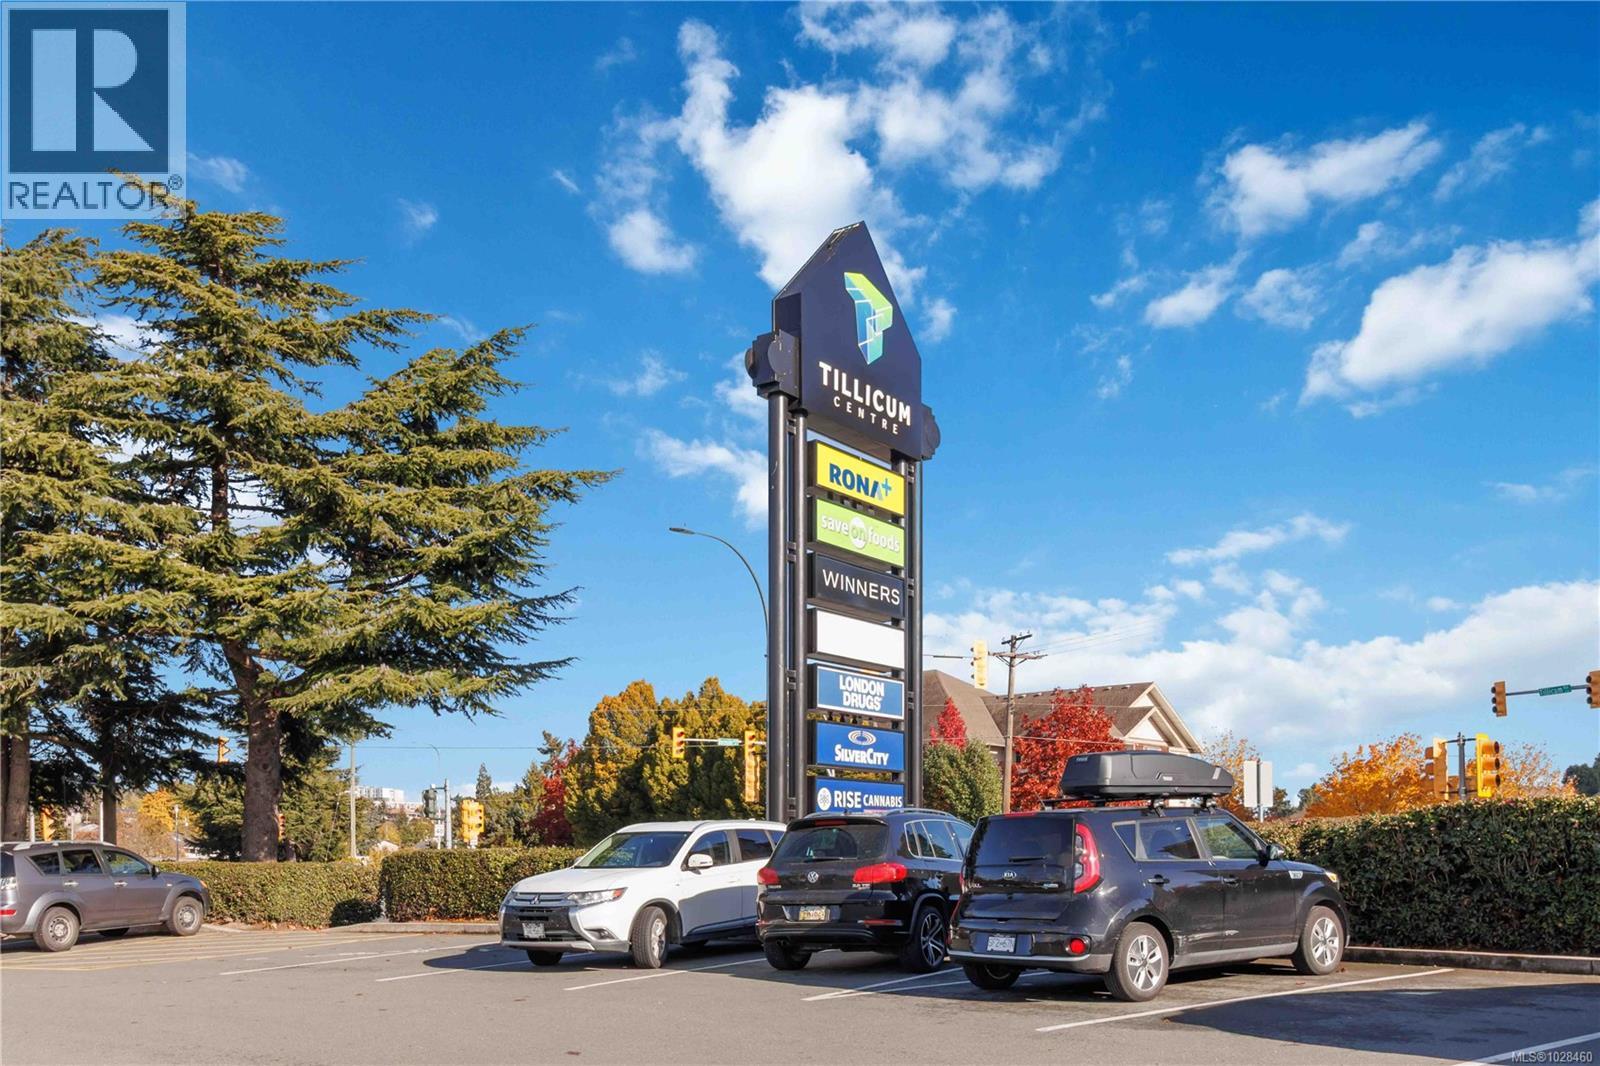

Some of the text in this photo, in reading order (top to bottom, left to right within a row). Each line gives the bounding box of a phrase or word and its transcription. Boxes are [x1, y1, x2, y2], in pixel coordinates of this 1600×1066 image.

[818, 361, 911, 426] TILLICUM
[833, 397, 898, 435] CENTRE
[821, 514, 900, 553] save on foods
[822, 568, 900, 605] WINNERS
[839, 675, 885, 697] LONDON
[843, 691, 882, 711] DRUGS
[834, 790, 903, 808] RISE CANNABIS
